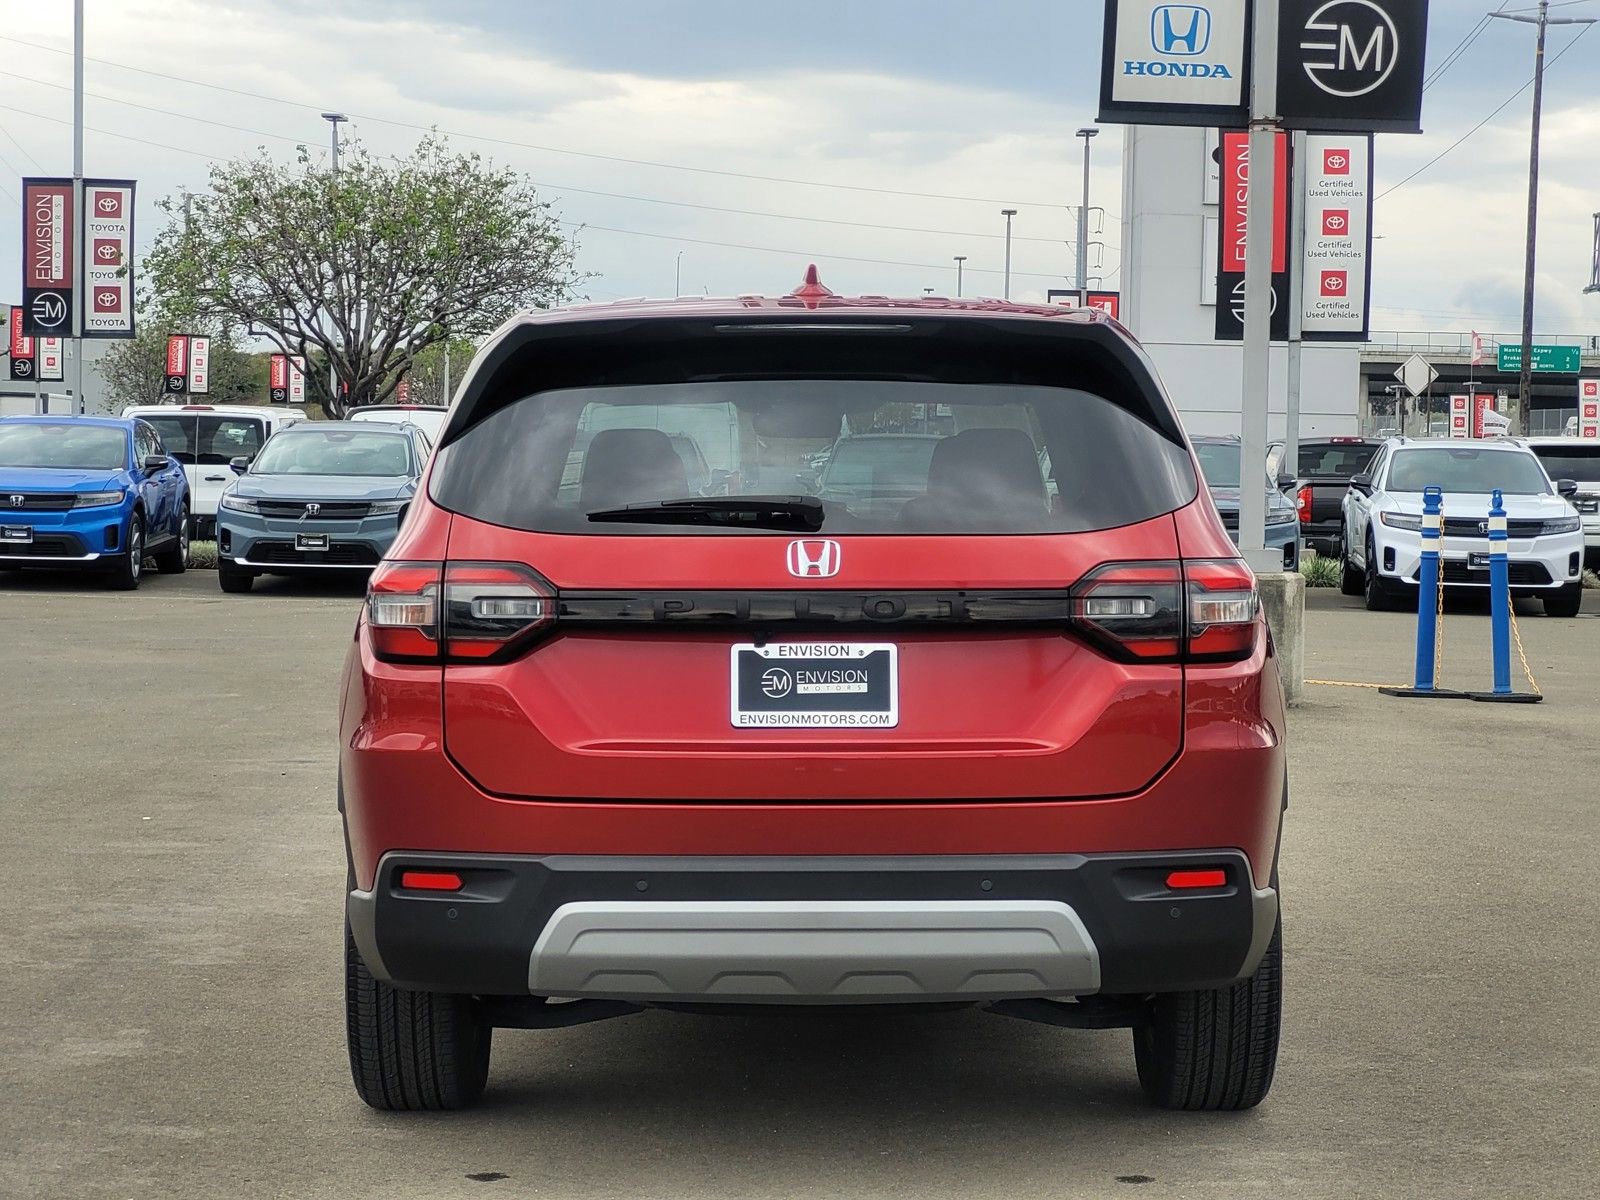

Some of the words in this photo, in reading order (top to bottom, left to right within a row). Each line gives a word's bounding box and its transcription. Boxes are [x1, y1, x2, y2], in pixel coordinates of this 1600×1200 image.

[1123, 60, 1233, 79] HONDA
[1318, 180, 1353, 188] Certified
[1331, 189, 1363, 197] Vehicles
[90, 224, 126, 232] TOYOTA
[35, 194, 51, 280] ENVISION
[54, 202, 62, 273] MOTORS
[1317, 241, 1352, 249] Certified
[1329, 250, 1361, 258] Vehicles
[90, 271, 125, 279] TOYO
[1327, 311, 1359, 319] Vehicles
[90, 319, 126, 327] TOYOTA
[15, 312, 24, 354] ENVISION
[170, 340, 179, 373] ENVISION
[654, 598, 977, 621] PILOT
[778, 645, 850, 657] ENVISION
[796, 669, 868, 684] ENVISION
[802, 684, 863, 692] MOTORS
[739, 714, 890, 725] ENVISIONMOTORS.COM
